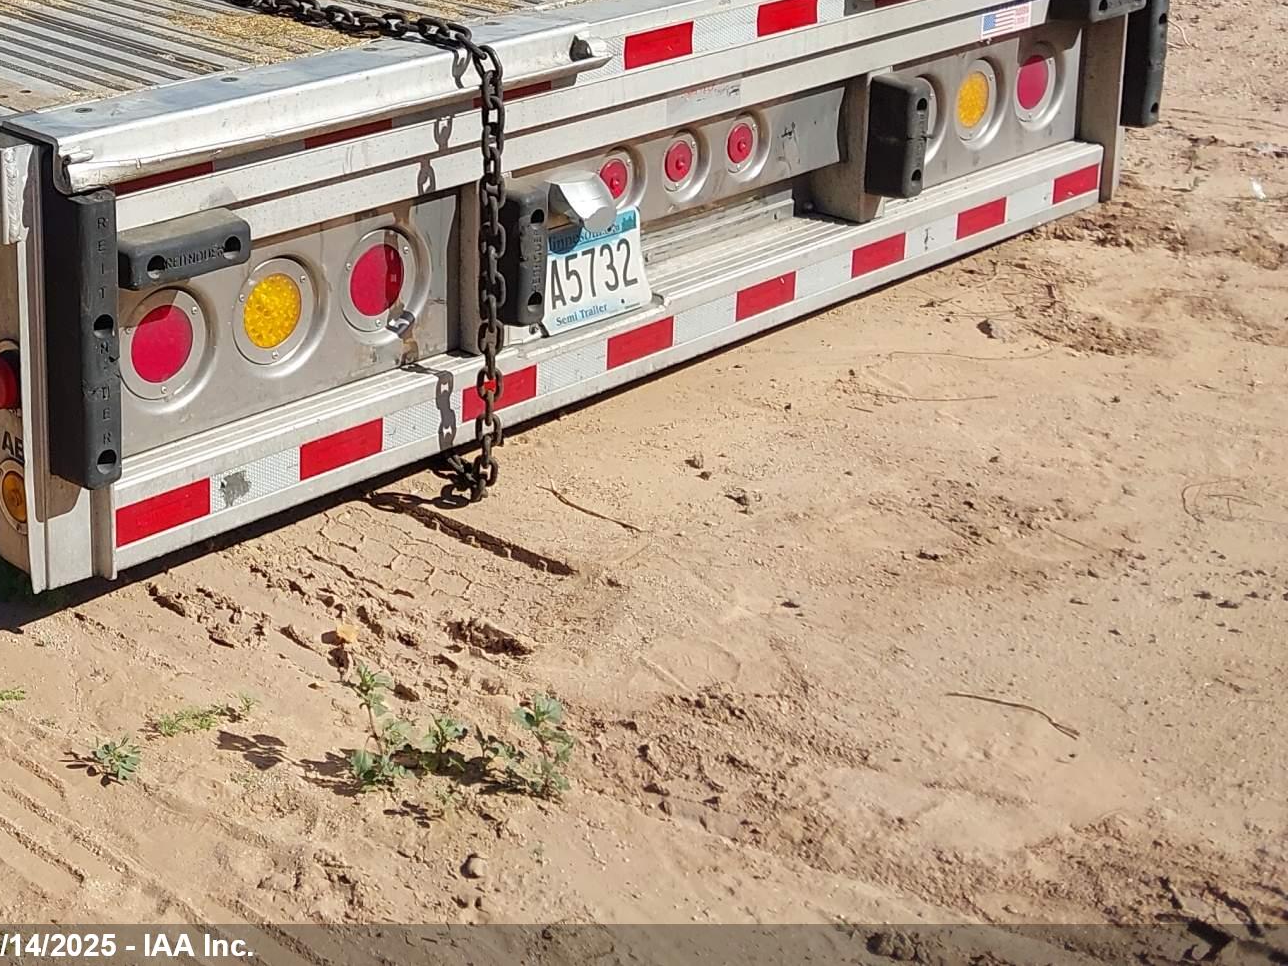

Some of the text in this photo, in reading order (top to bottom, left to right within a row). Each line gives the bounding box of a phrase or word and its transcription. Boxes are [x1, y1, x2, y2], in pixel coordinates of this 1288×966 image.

[551, 237, 638, 310] A5732
[556, 303, 608, 327] Semi Trailer
